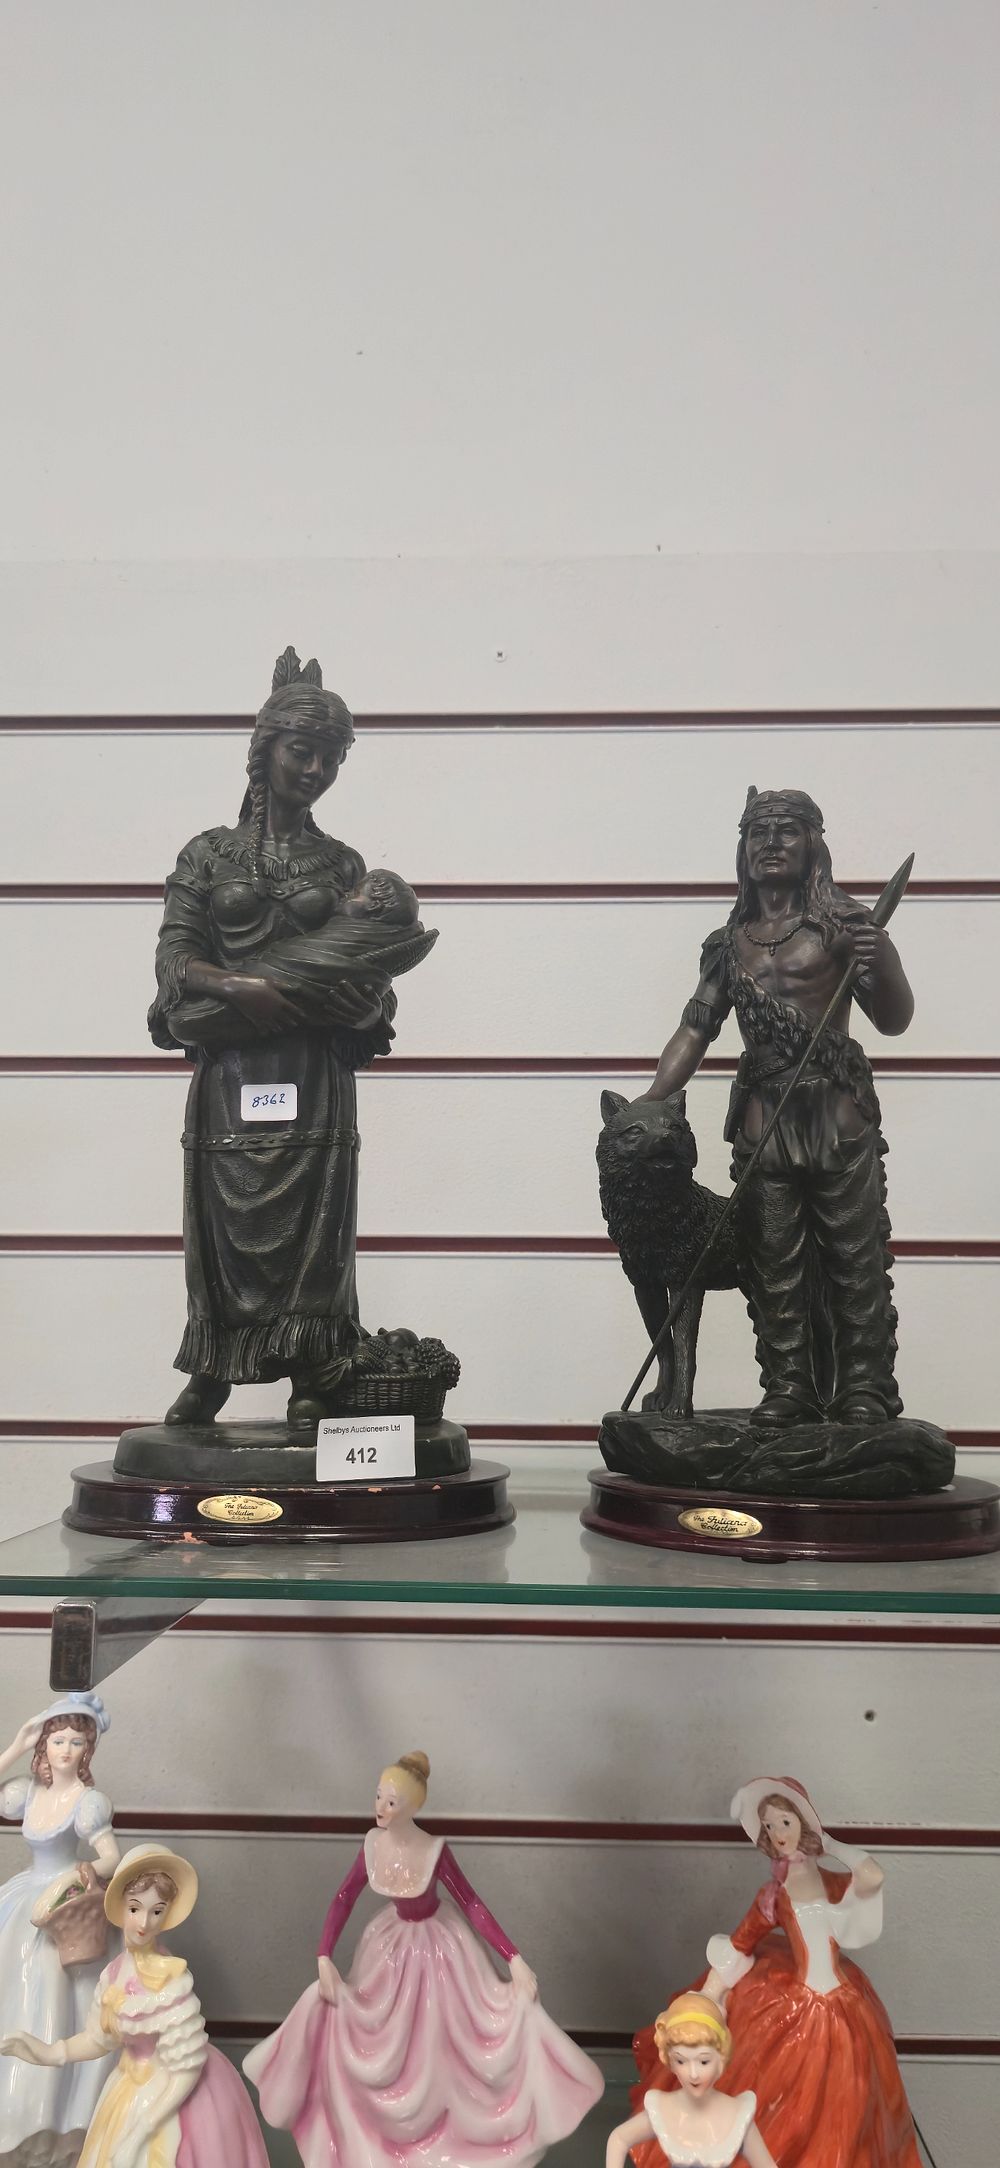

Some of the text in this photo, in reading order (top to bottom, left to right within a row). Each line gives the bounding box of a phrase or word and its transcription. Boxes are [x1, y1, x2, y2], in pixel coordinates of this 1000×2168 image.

[251, 1093, 286, 1108] 8362
[323, 1423, 401, 1435] Shelbys Auctioneers Ltd
[345, 1447, 377, 1464] 412
[700, 1522, 739, 1533] Collection
